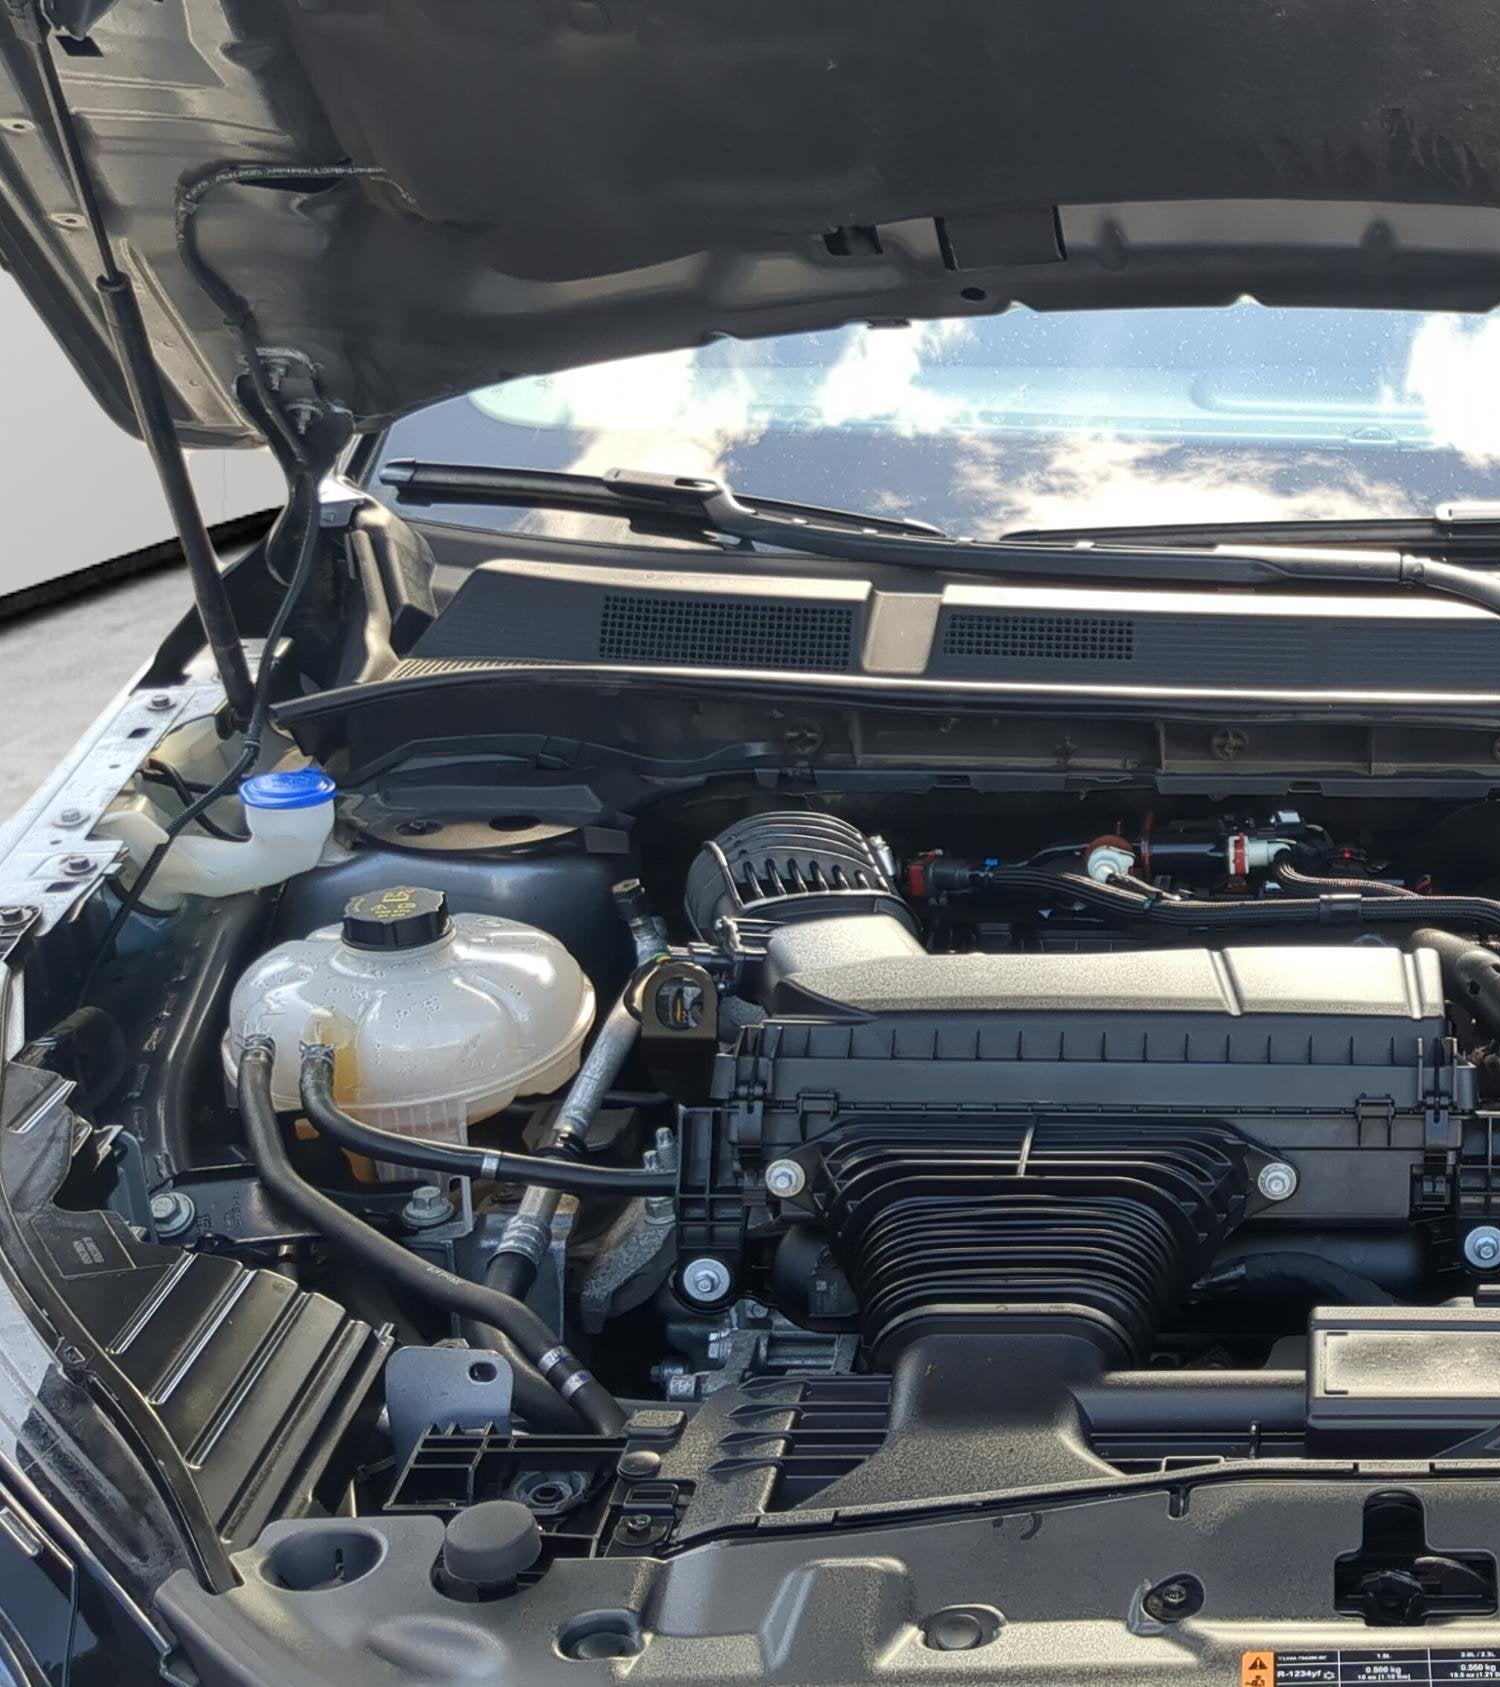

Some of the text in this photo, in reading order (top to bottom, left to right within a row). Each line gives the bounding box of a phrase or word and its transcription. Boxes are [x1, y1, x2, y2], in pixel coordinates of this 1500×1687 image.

[1390, 1665, 1402, 1674] kg
[1485, 1663, 1497, 1672] kg
[1277, 1669, 1322, 1679] R-1234yf
